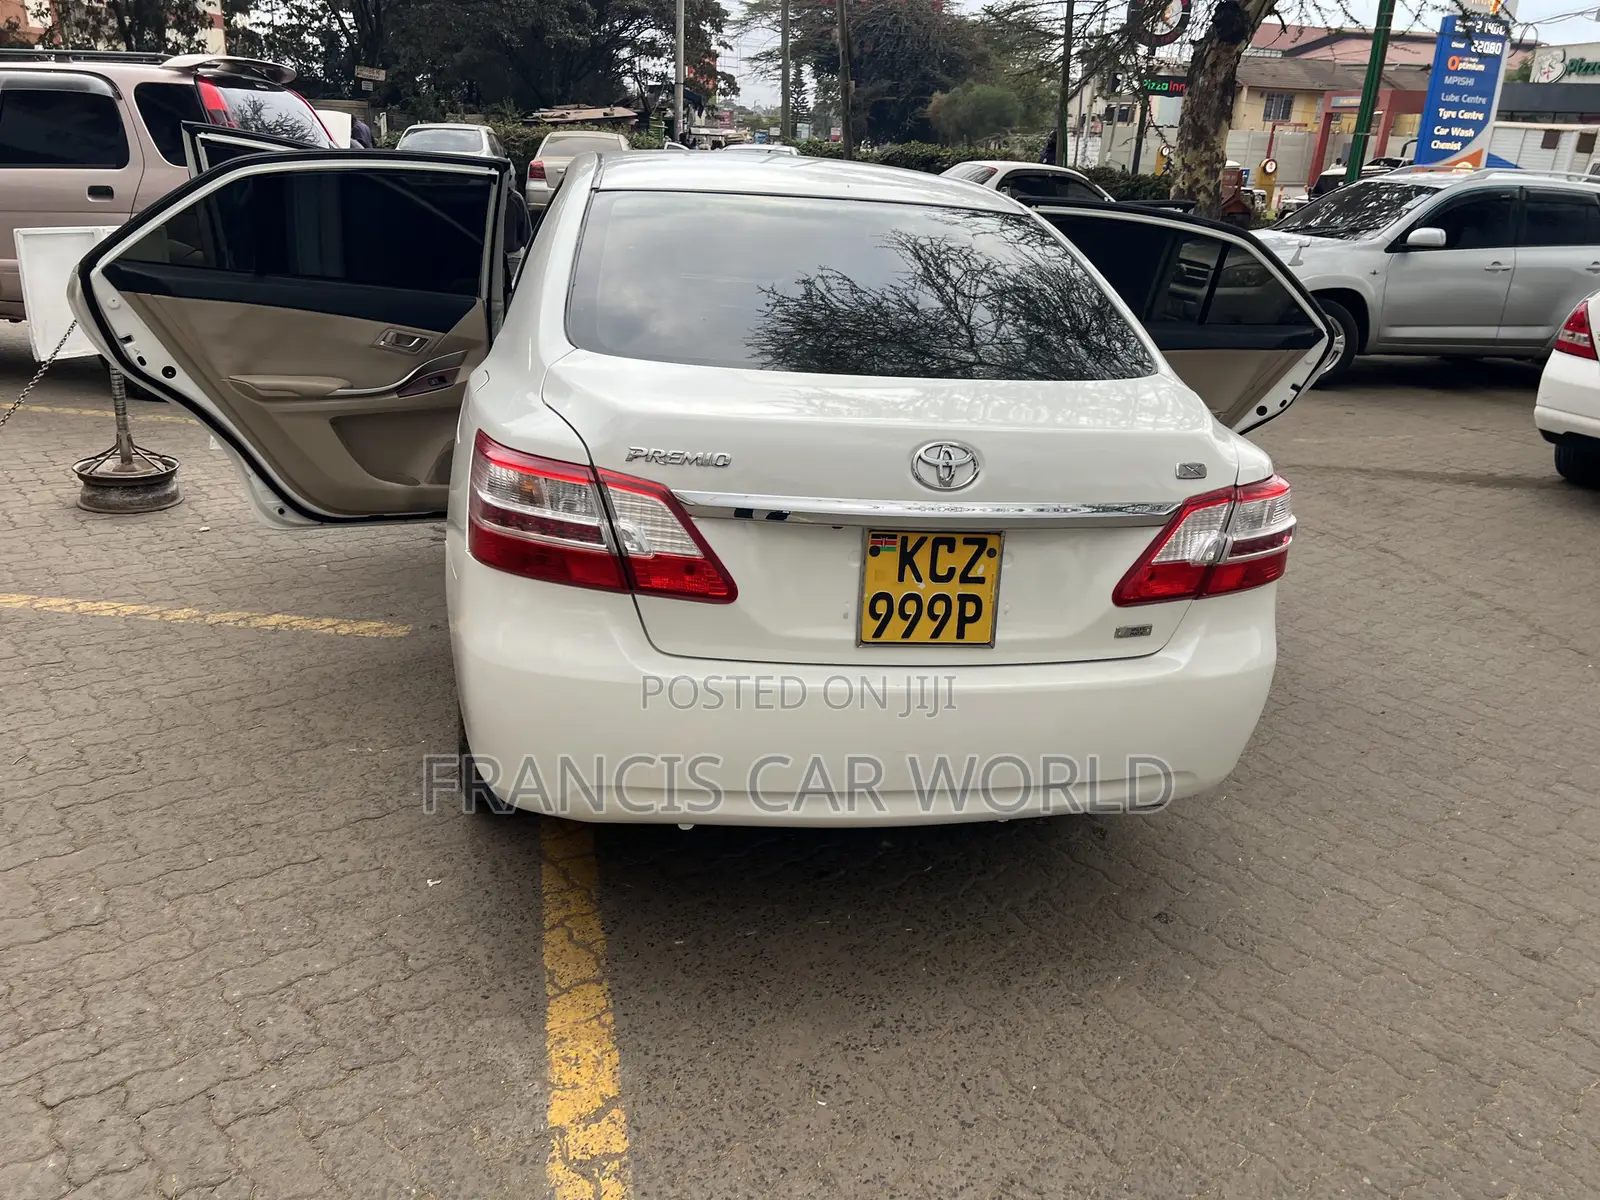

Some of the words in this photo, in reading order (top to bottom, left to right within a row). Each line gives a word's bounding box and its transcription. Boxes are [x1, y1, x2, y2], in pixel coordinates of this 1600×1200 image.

[1143, 79, 1169, 92] Pizza
[1169, 81, 1186, 92] Inn
[1444, 76, 1476, 87] MPISHI
[1440, 92, 1460, 103] Lube
[1461, 93, 1487, 105] Centre
[1438, 108, 1457, 120] Tyre
[1458, 109, 1485, 121] Centre
[1433, 125, 1449, 136] Car
[1451, 126, 1475, 138] Wash
[1430, 140, 1462, 151] Chemist
[625, 446, 732, 468] PREMIO
[897, 535, 989, 584] KCZ
[868, 591, 983, 640] 999P
